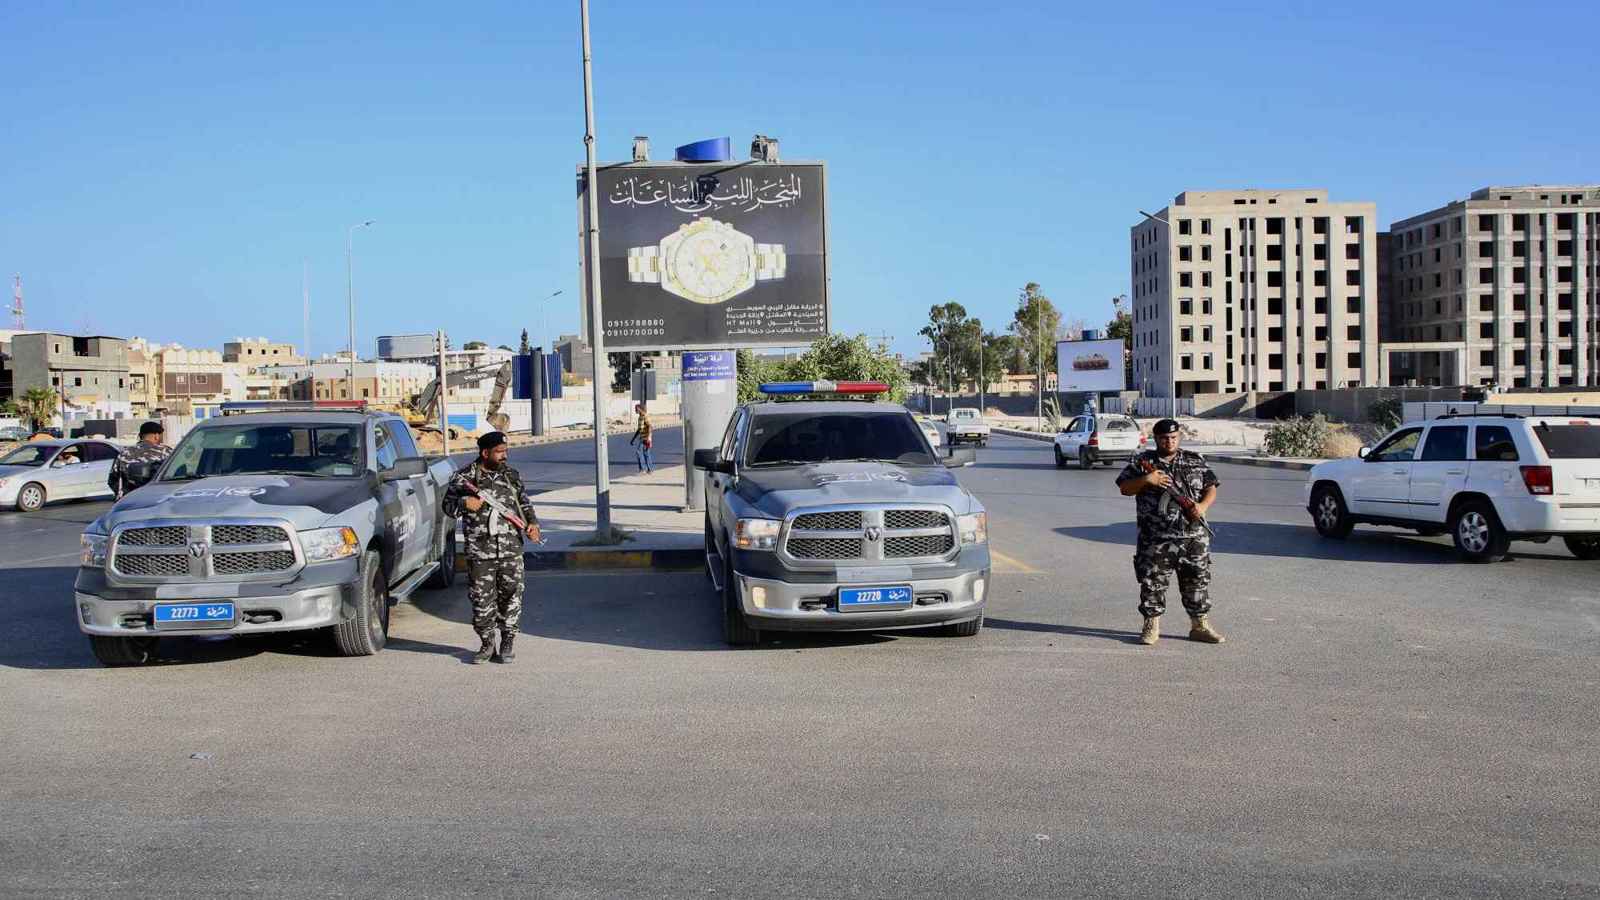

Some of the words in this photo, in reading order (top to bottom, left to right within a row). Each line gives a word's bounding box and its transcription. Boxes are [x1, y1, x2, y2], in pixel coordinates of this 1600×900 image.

[609, 176, 700, 208] للساعات
[743, 173, 801, 212] المتجر
[171, 606, 199, 619] 22773
